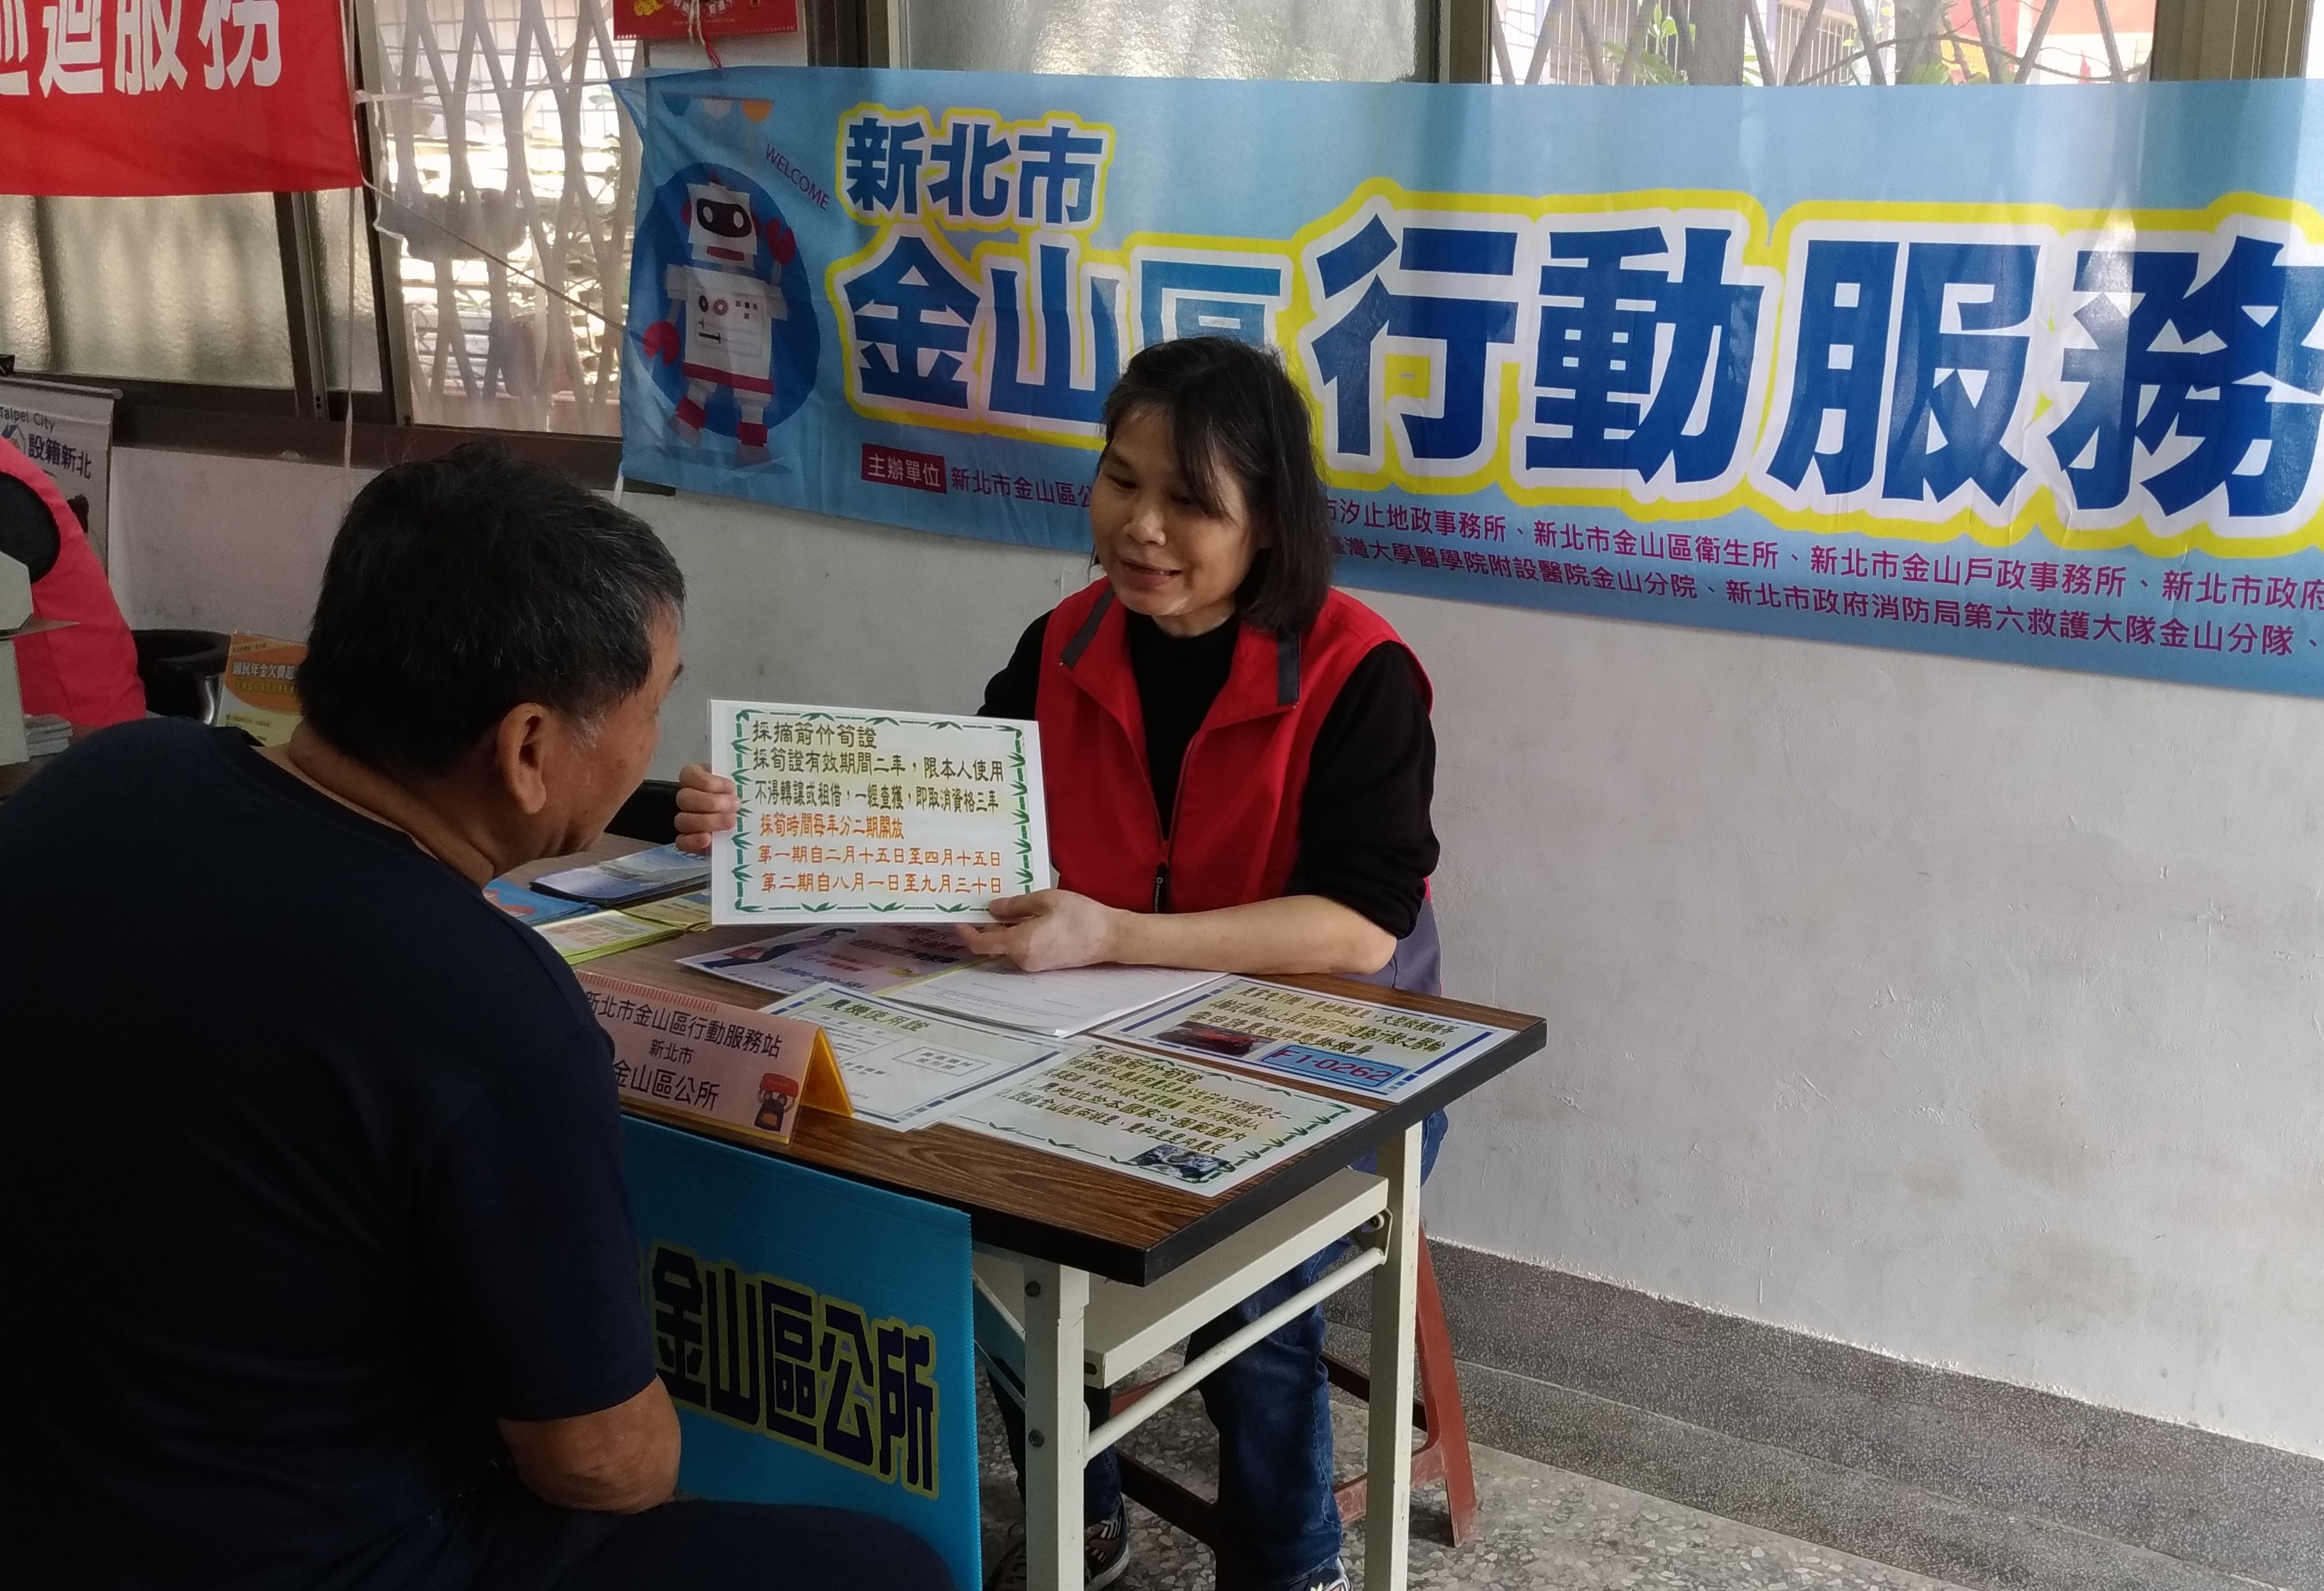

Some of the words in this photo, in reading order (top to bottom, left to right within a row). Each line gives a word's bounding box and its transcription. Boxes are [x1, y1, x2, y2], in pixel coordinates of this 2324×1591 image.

[764, 143, 830, 212] WELCOME
[845, 117, 1104, 224] 新北市
[0, 406, 30, 423] Taipei
[33, 412, 55, 433] City
[29, 433, 93, 480] 設籍新北
[867, 452, 942, 488] 主辦單位
[752, 720, 878, 750] 採摘箭竹筍證
[759, 811, 905, 840] 採筍時間每年分二期開放
[757, 845, 1001, 867] 第一期自二月十五日至四月十五日
[761, 872, 1003, 895] 第二期自八月一日至九月三十日
[586, 989, 783, 1059] 新北市金山區行動服務站
[649, 1038, 694, 1065] 新北市
[613, 1059, 721, 1112] 金山區公所
[652, 1246, 935, 1492] 金山區公所
